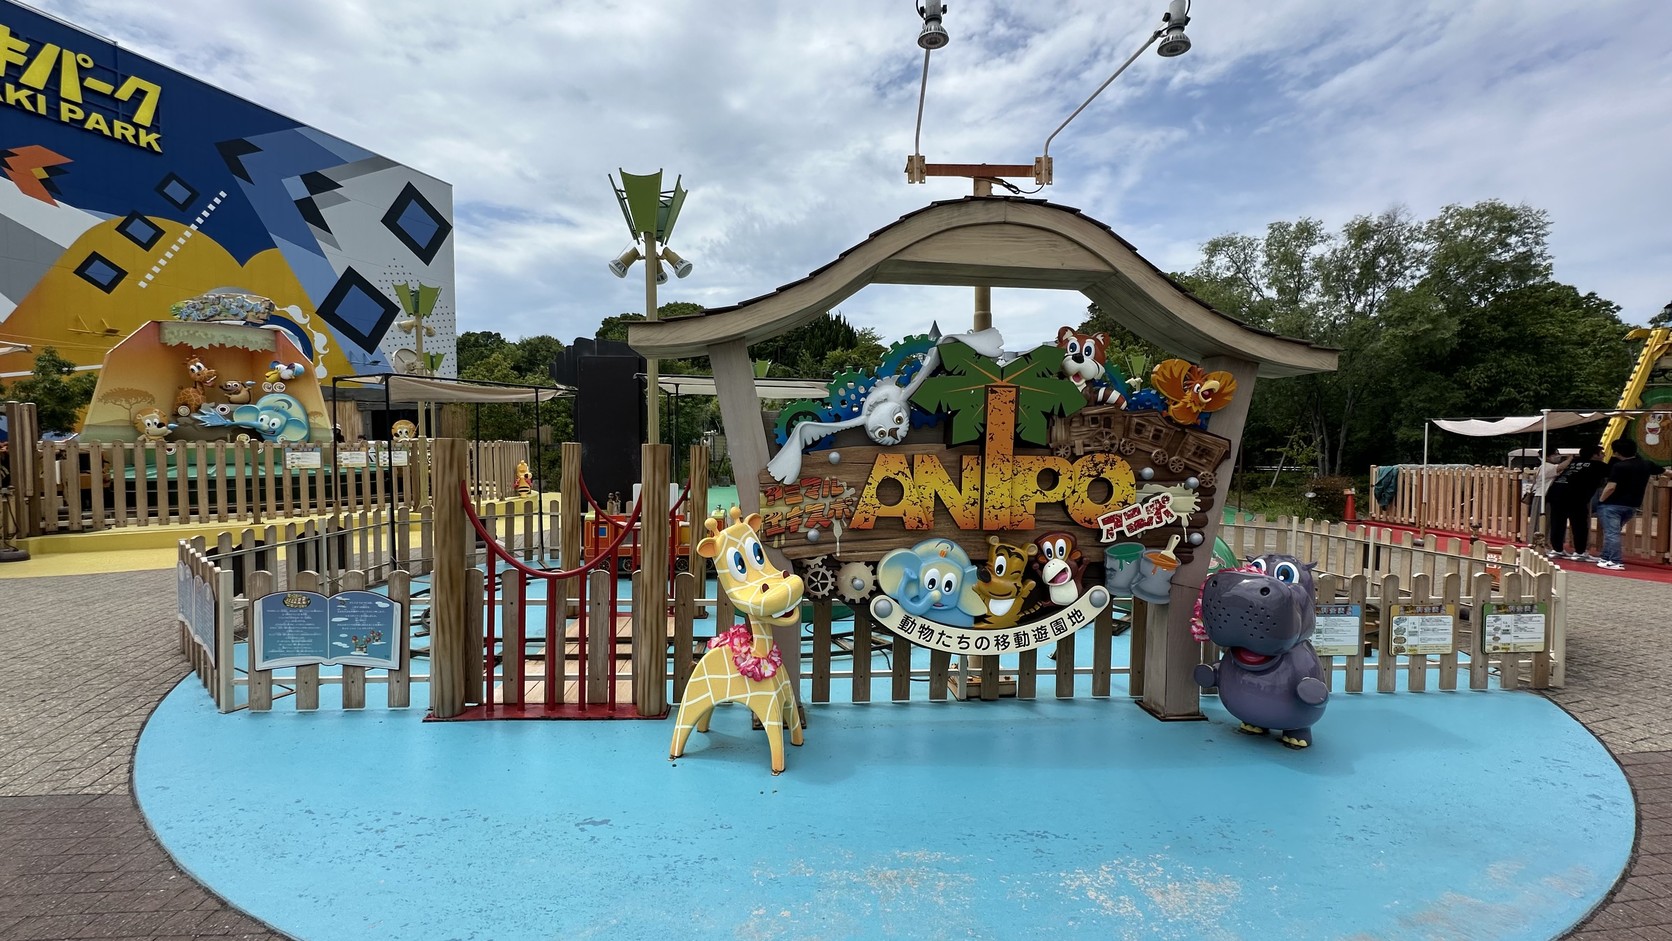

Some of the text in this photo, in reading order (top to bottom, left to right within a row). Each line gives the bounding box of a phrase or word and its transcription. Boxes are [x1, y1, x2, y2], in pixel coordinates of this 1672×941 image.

[0, 82, 163, 153] KI PARK
[849, 386, 1137, 530] ANIPO
[764, 477, 845, 506] アニマル
[764, 497, 853, 537] エキスポ
[1098, 494, 1176, 541] アニポ
[897, 608, 1086, 651] 動物たちの移動遊園地
